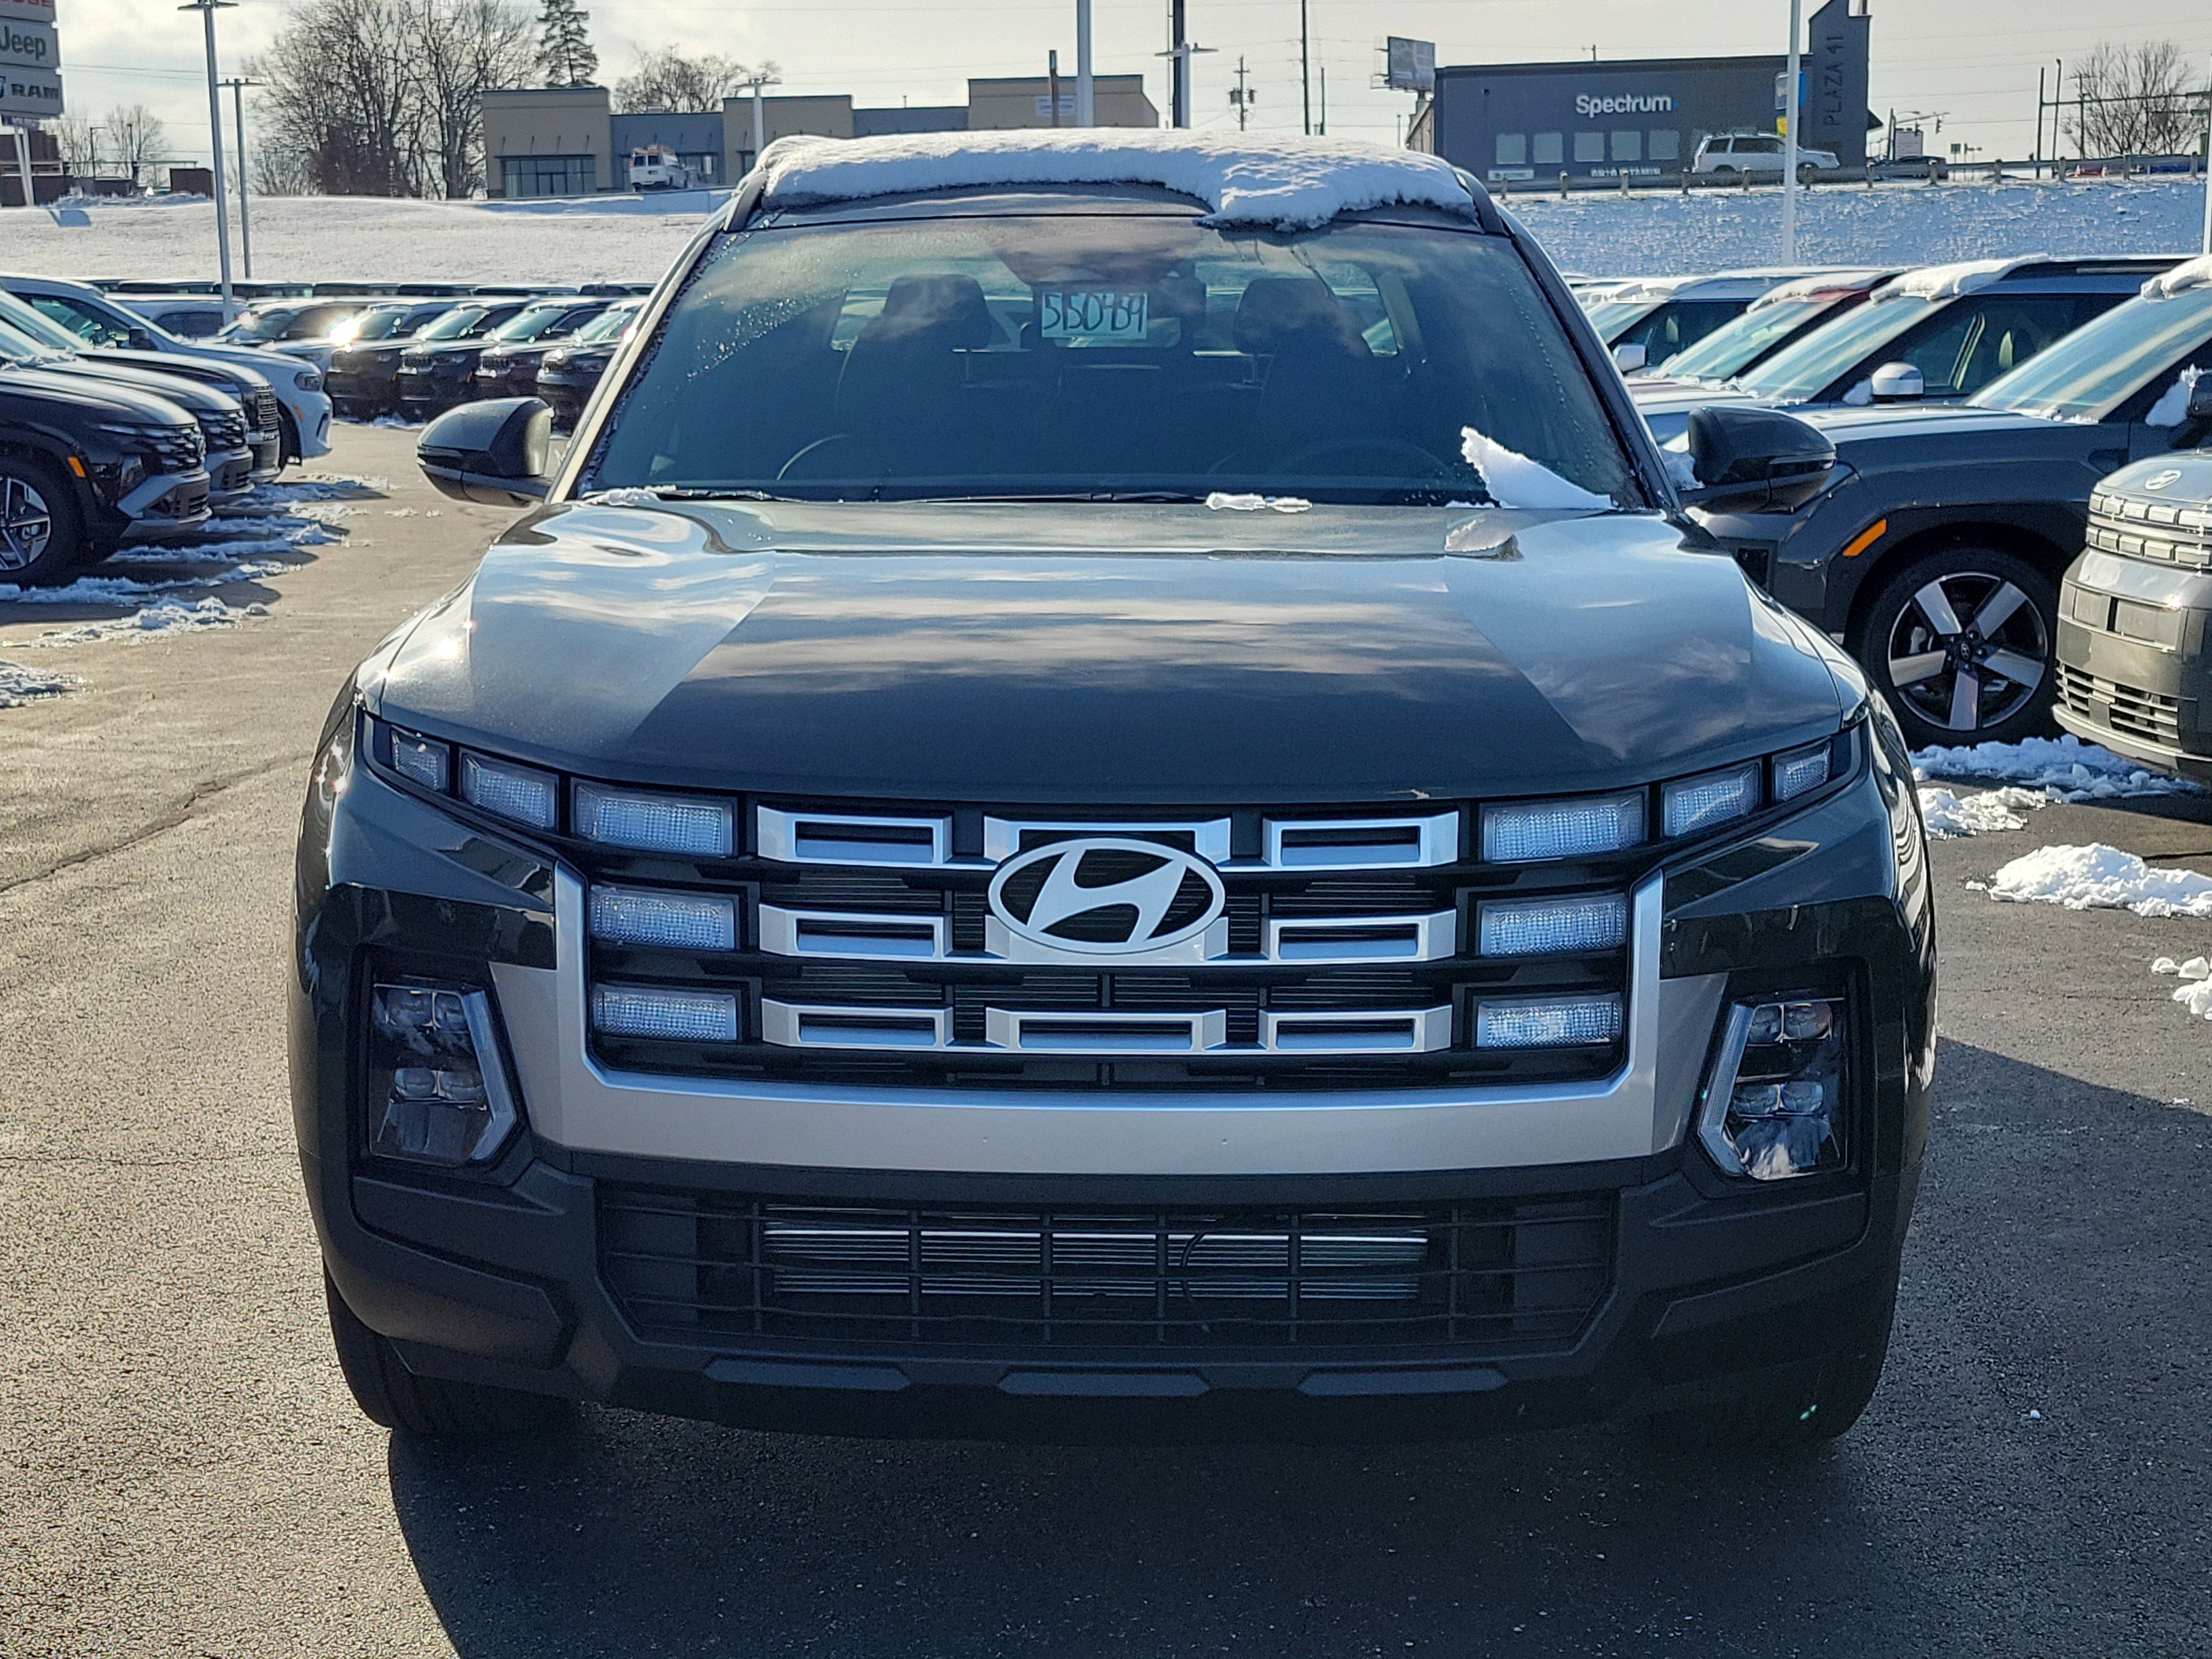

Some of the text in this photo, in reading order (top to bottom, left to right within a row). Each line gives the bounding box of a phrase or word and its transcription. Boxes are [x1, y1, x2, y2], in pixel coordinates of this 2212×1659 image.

[0, 26, 46, 61] Jeep
[11, 83, 59, 100] RAM
[1822, 36, 1844, 126] PLAZA 41
[1576, 93, 1672, 119] Spectrum
